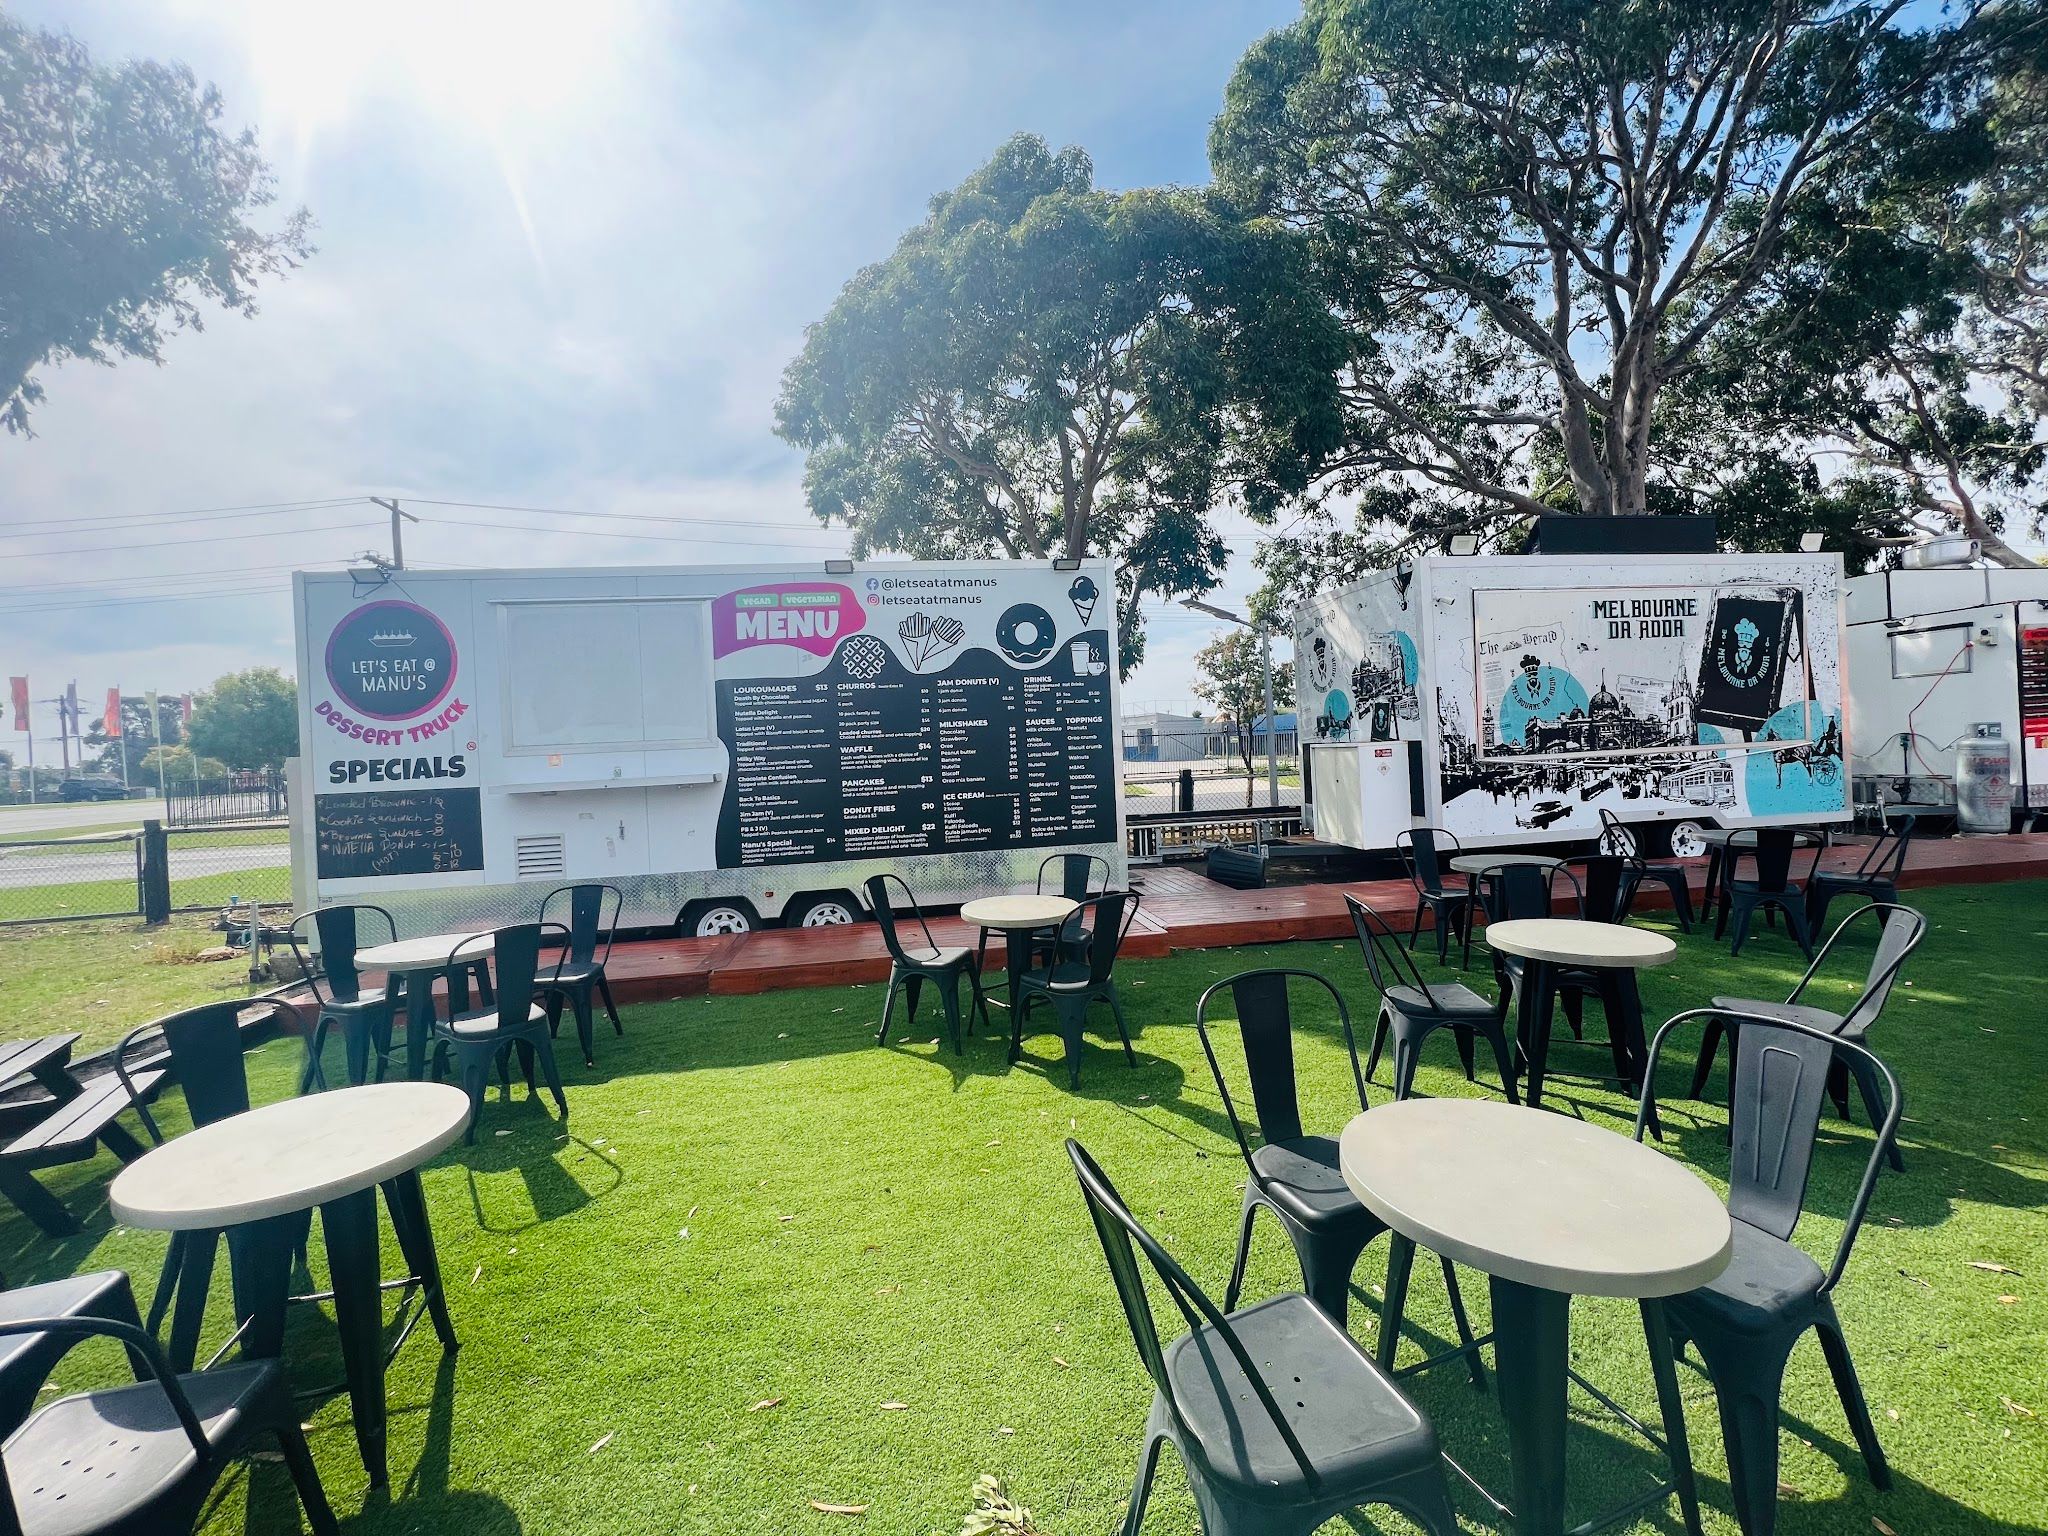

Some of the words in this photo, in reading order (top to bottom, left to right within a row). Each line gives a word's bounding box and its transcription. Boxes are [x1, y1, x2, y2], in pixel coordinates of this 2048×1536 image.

[882, 577, 997, 591] @letseatatmanus
[882, 594, 982, 605] letseatatmanus
[736, 610, 839, 640] MENU
[1608, 621, 1632, 639] DA
[1639, 620, 1685, 640] ADDA
[1480, 641, 1499, 655] The
[1523, 631, 1557, 645] Herald
[352, 660, 387, 673] LET'S
[394, 659, 417, 672] EAT
[424, 659, 435, 671] @
[362, 675, 426, 692] MANU'S
[734, 685, 797, 693] LOUKOUMADES
[407, 698, 469, 742] TRUCK
[940, 720, 988, 728] MILKSHAKES
[329, 755, 466, 783] SPECIALS
[842, 779, 885, 787] PANCAKES
[872, 825, 905, 833] DELIGHT
[767, 839, 792, 847] Special
